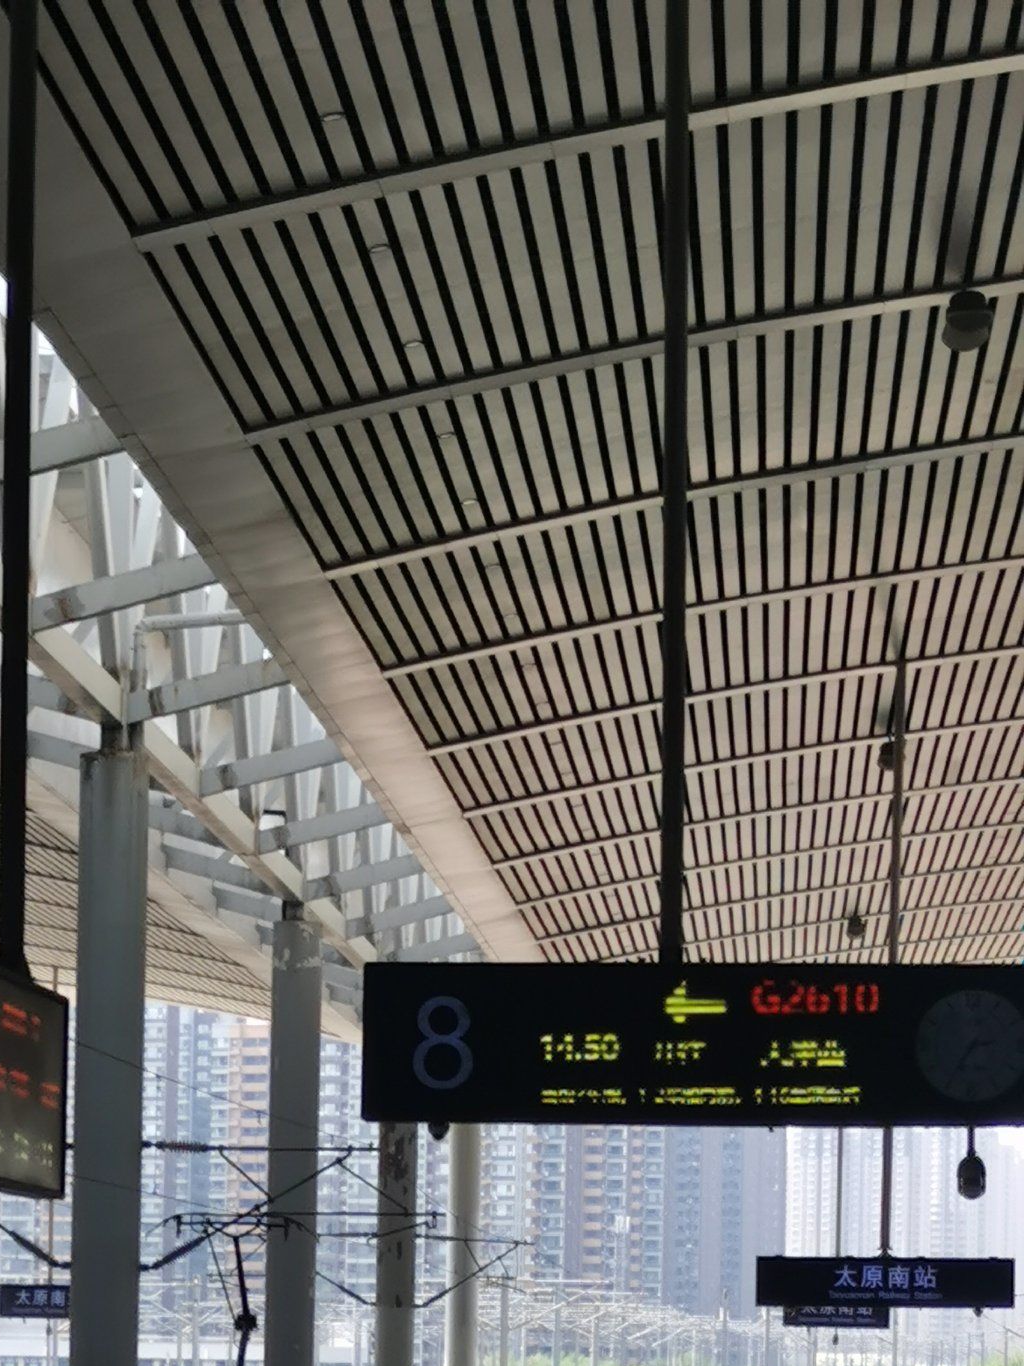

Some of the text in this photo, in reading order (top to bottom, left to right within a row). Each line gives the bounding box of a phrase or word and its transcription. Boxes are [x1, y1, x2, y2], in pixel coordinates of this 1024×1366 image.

[751, 979, 880, 1015] G2610
[413, 995, 473, 1090] 8
[834, 1265, 937, 1289] 太原南站
[14, 1289, 69, 1307] 太原南
